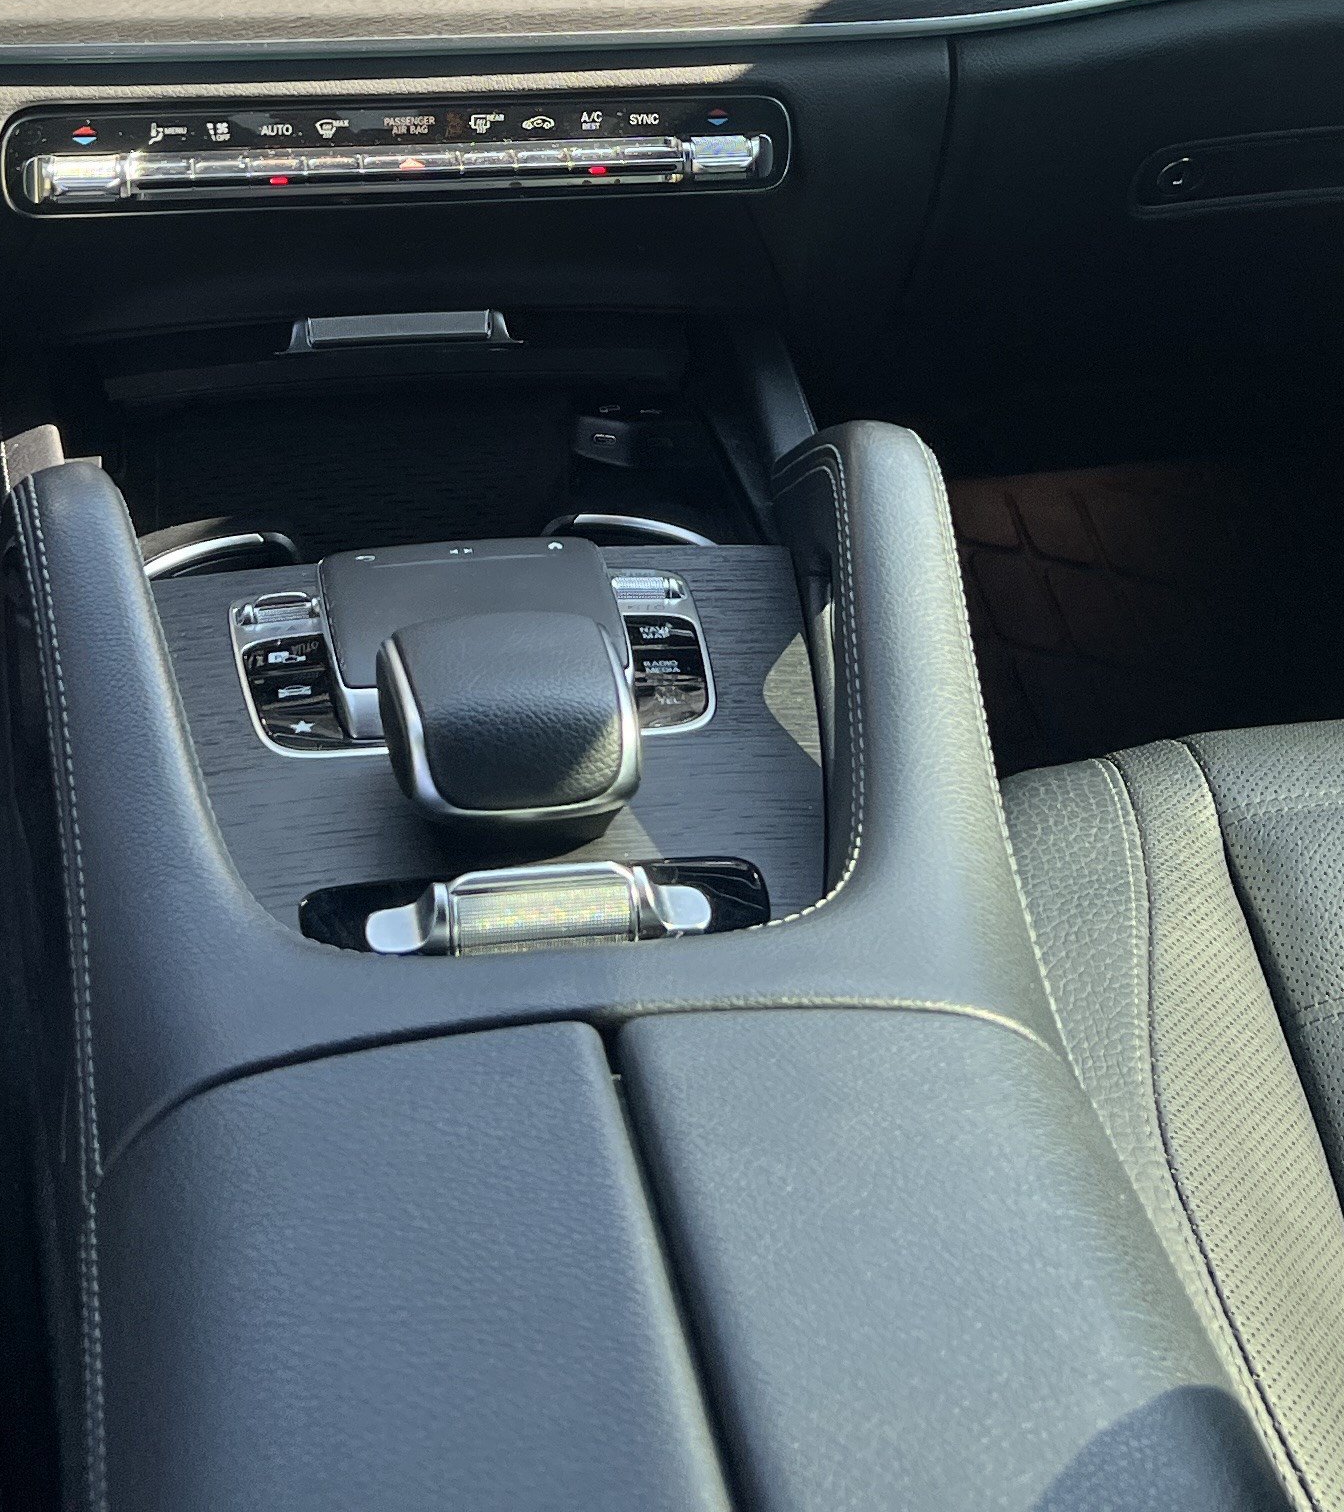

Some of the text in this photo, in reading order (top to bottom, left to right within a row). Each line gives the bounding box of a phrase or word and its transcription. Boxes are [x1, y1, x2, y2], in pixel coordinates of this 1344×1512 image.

[383, 116, 435, 127] PASSENGER
[580, 111, 602, 123] A/C
[629, 113, 660, 125] SYNC
[333, 119, 349, 128] MAX
[260, 124, 293, 136] AUTO
[392, 124, 428, 135] AIR BAG
[643, 659, 678, 667] RADIO
